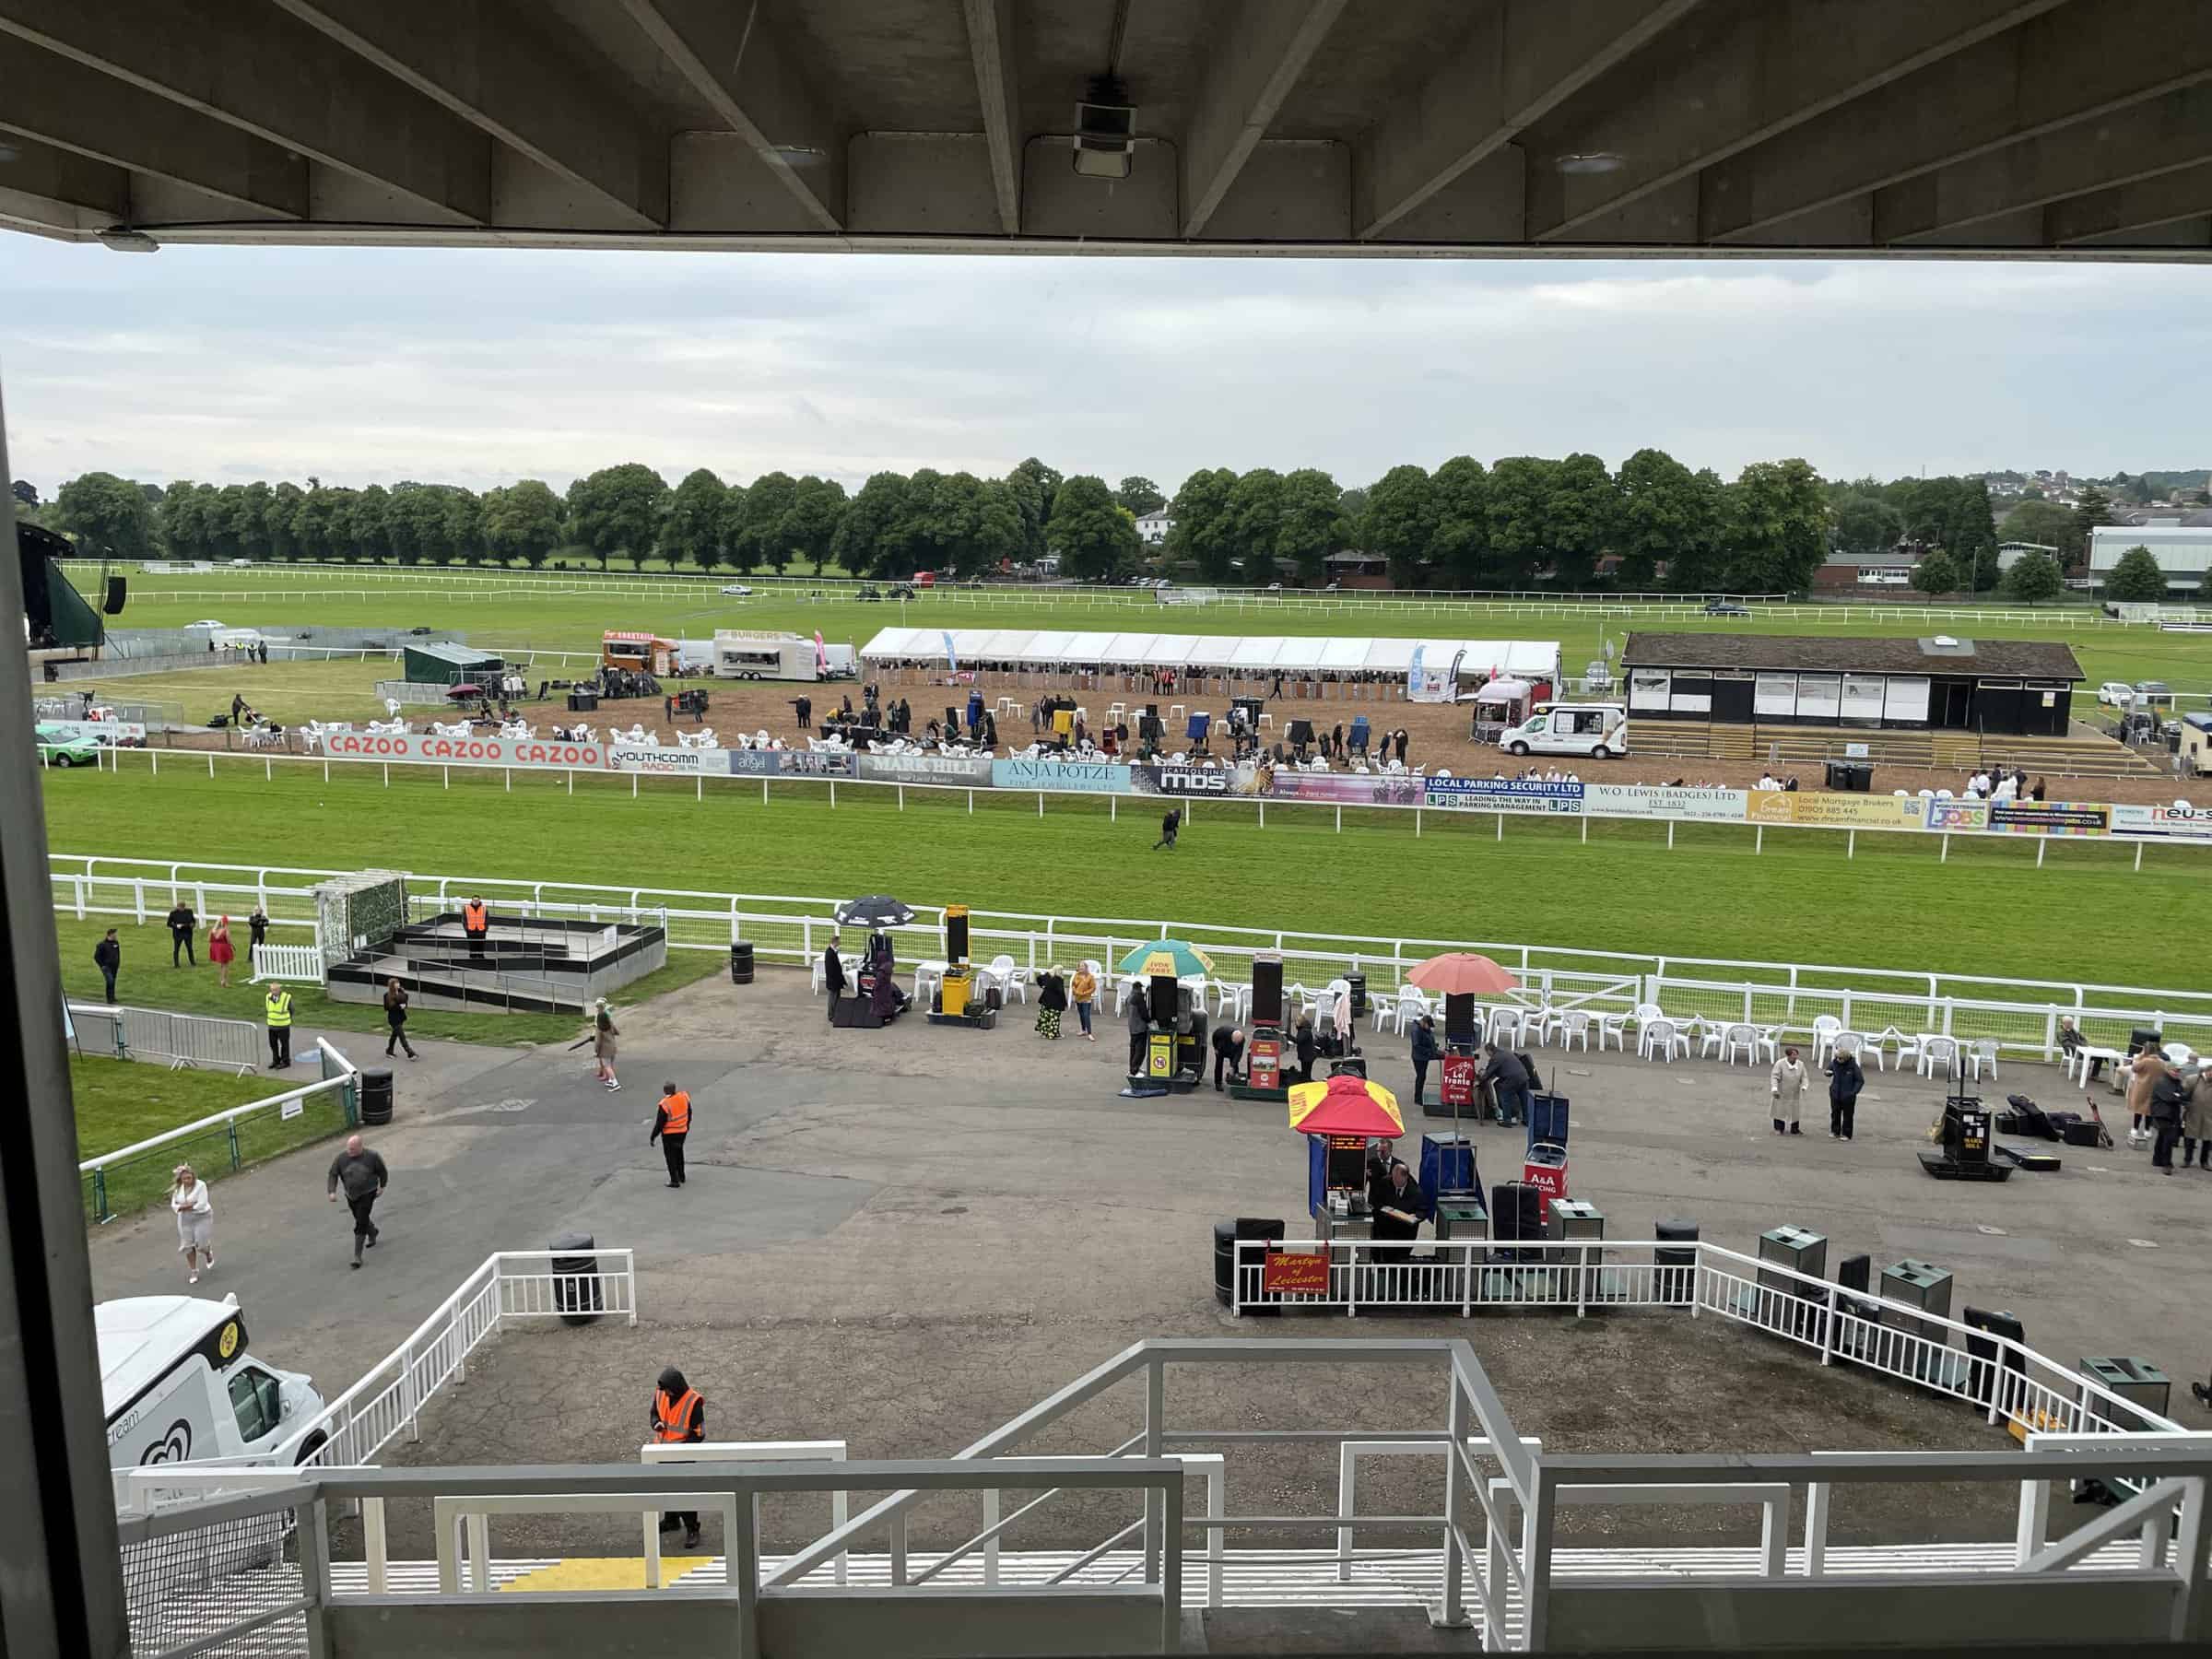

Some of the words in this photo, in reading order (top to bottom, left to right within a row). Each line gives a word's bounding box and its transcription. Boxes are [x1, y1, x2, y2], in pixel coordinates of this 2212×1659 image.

[330, 735, 408, 756] CAZOO
[421, 739, 502, 760] CAZOO
[515, 744, 598, 765] CAZOO
[616, 751, 699, 765] YOUTHCOMM
[872, 756, 931, 772] MARK
[932, 758, 978, 775] HILL
[1008, 761, 1052, 781] ANJA
[1056, 764, 1116, 781] POTZE
[1162, 767, 1226, 775] SCAFFOLDING
[1429, 778, 1463, 788] LOCAL
[1464, 780, 1509, 790] PARKING
[1510, 782, 1560, 792] SECURITY
[1560, 783, 1581, 793] LTD
[1465, 795, 1498, 804] LEADING
[1628, 788, 1659, 797] LEWIS
[1661, 789, 1712, 800] (BADGES)
[1798, 795, 1819, 804] Local
[1821, 797, 1861, 807] Mortgage
[1863, 798, 1894, 807] Brokers
[1492, 803, 1547, 812] MANAGEMENT
[1531, 1173, 1556, 1186] A&A
[1274, 1255, 1323, 1267] Martyn
[1291, 1266, 1303, 1277] of
[1268, 1275, 1325, 1286] Leicester
